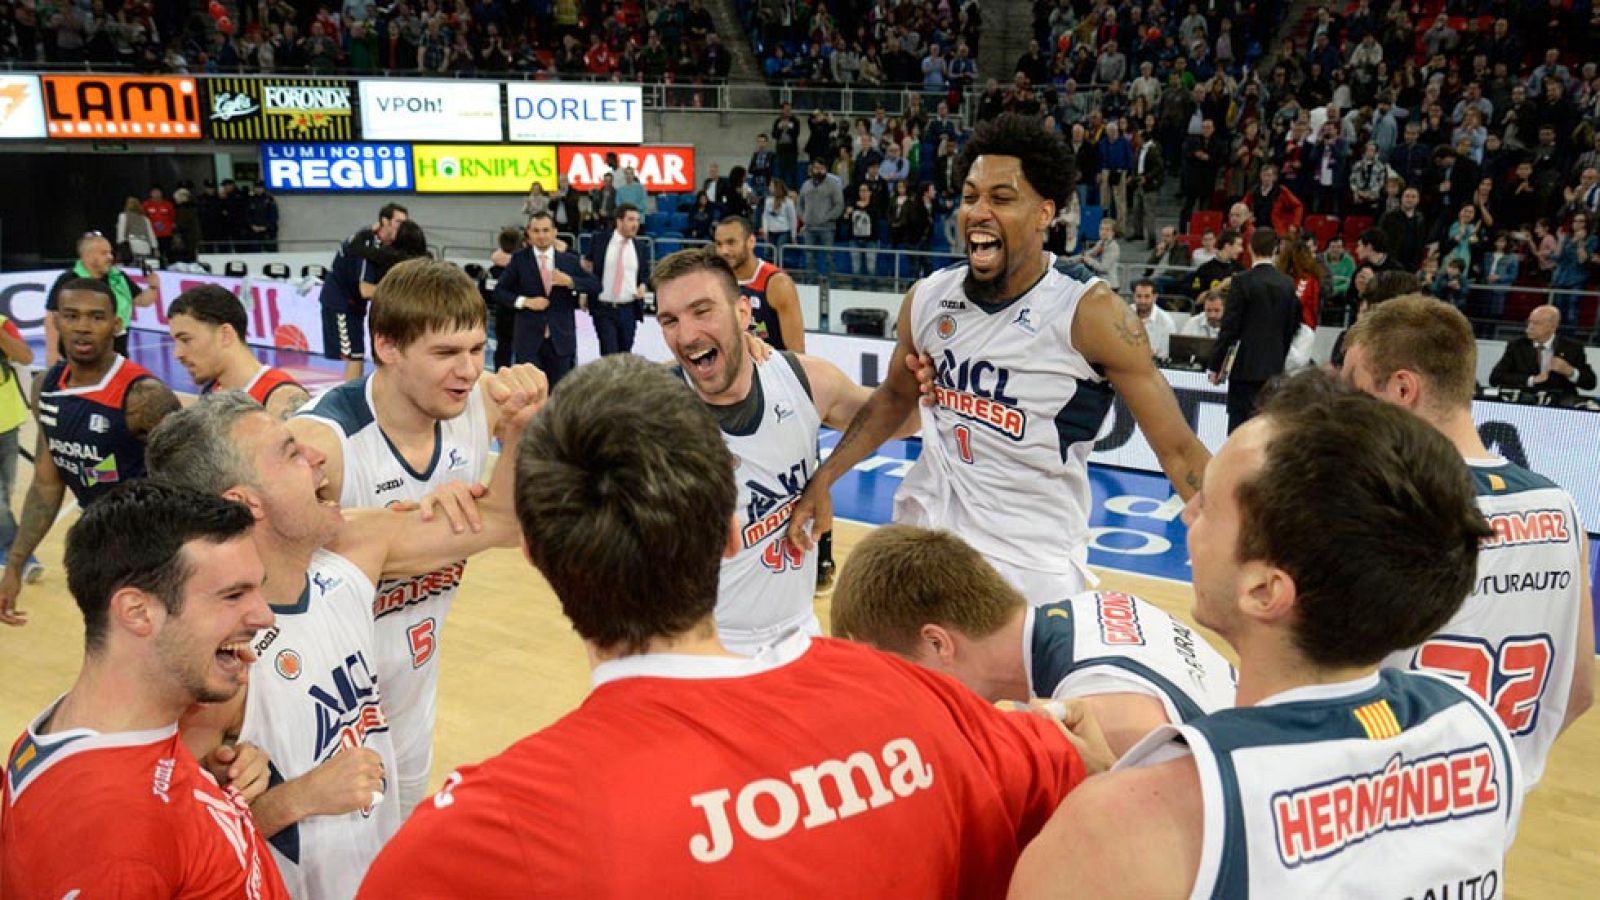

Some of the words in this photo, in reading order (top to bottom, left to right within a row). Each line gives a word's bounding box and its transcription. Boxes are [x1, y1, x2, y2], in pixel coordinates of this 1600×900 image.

[265, 87, 350, 109] FORONDA
[515, 97, 636, 121] DORLET
[268, 146, 405, 158] LUMINOSOS
[418, 156, 552, 178] HORNIPLAS
[270, 159, 408, 189] REGUI
[935, 387, 1024, 439] ANRESA
[955, 424, 973, 464] 1
[407, 618, 435, 669] 5
[688, 737, 935, 863] Joma
[1273, 745, 1499, 867] HERNÁNDEZ
